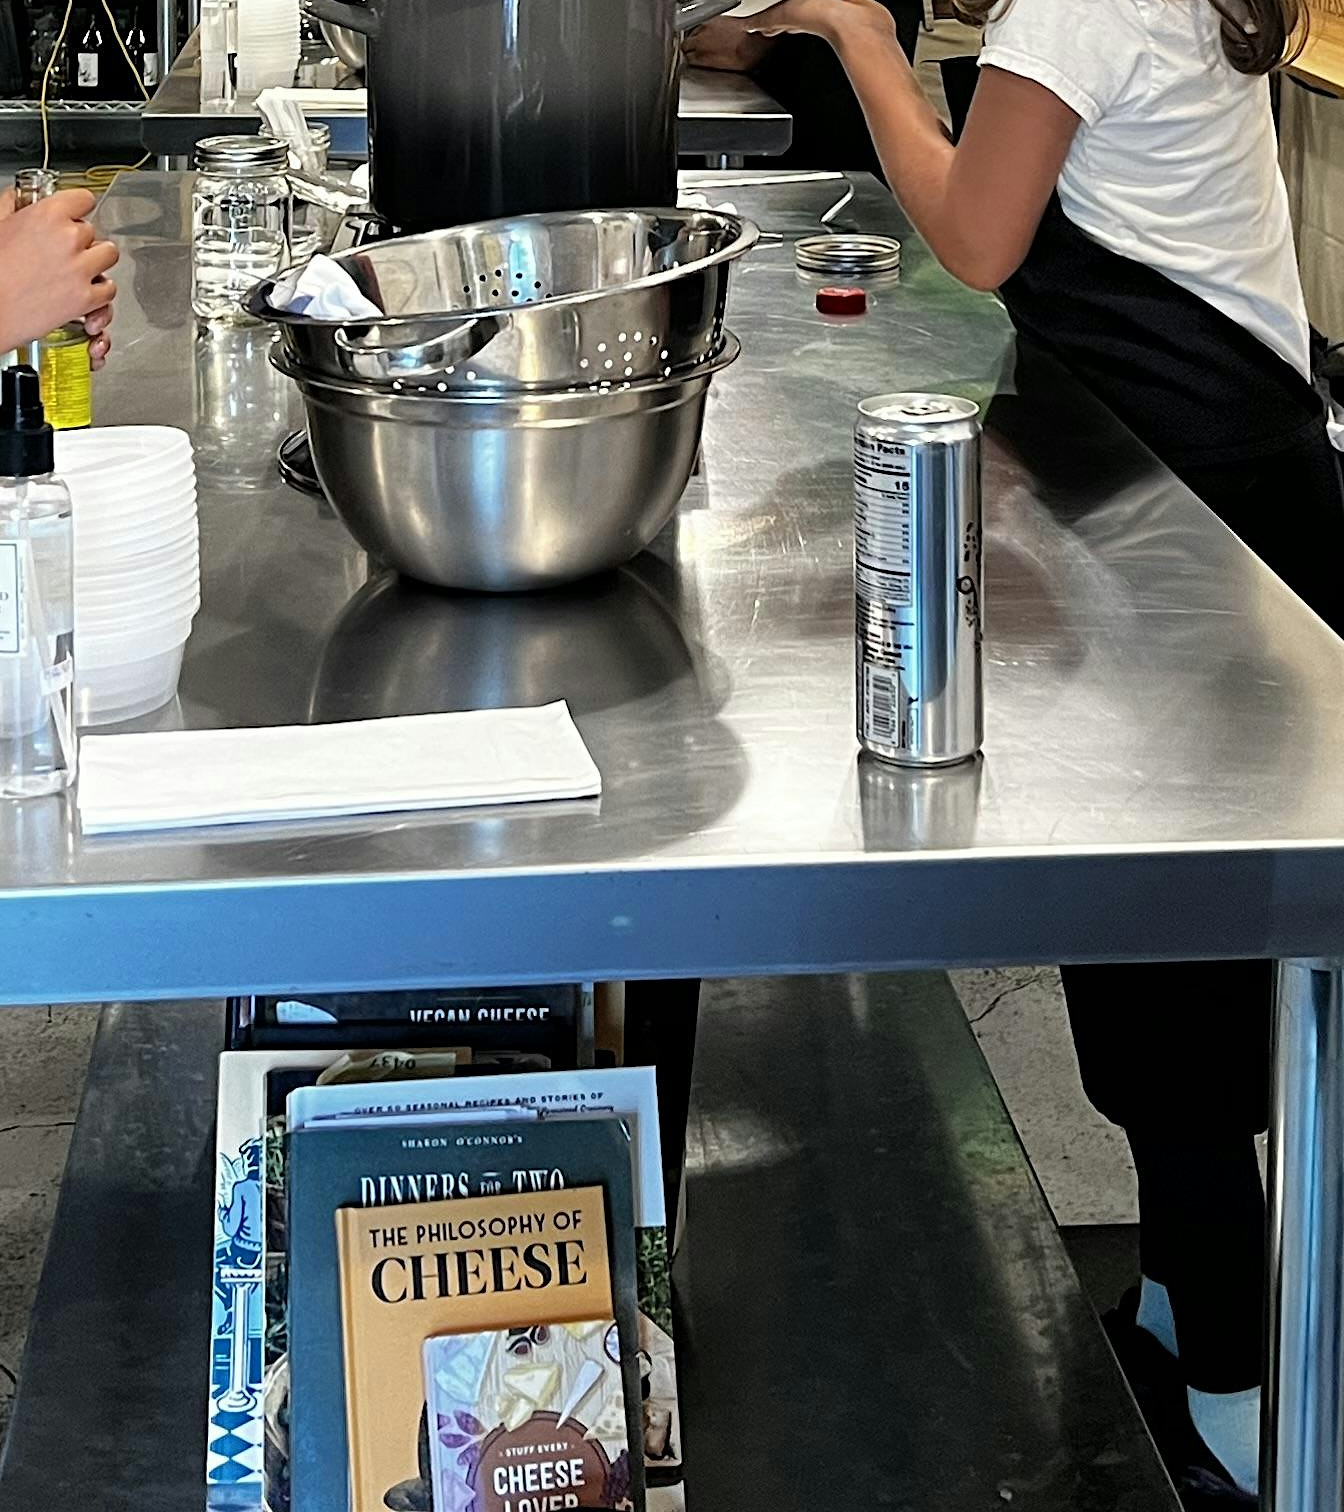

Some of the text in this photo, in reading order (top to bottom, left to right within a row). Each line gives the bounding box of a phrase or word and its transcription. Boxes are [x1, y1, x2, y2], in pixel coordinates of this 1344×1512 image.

[406, 1100, 460, 1112] SEASONAL
[464, 1098, 511, 1109] RECIPES
[516, 1096, 537, 1105] AND
[541, 1093, 586, 1104] STORIES
[590, 1092, 604, 1100] OF
[402, 1139, 447, 1148] SHARON
[360, 1172, 470, 1208] DINNERS
[512, 1168, 565, 1192] TWO
[369, 1209, 582, 1248] THE PHILOSOPHY OF
[371, 1240, 587, 1304] CHEESE
[506, 1442, 568, 1457] STUFF EVERY
[493, 1458, 586, 1496] CHEESE
